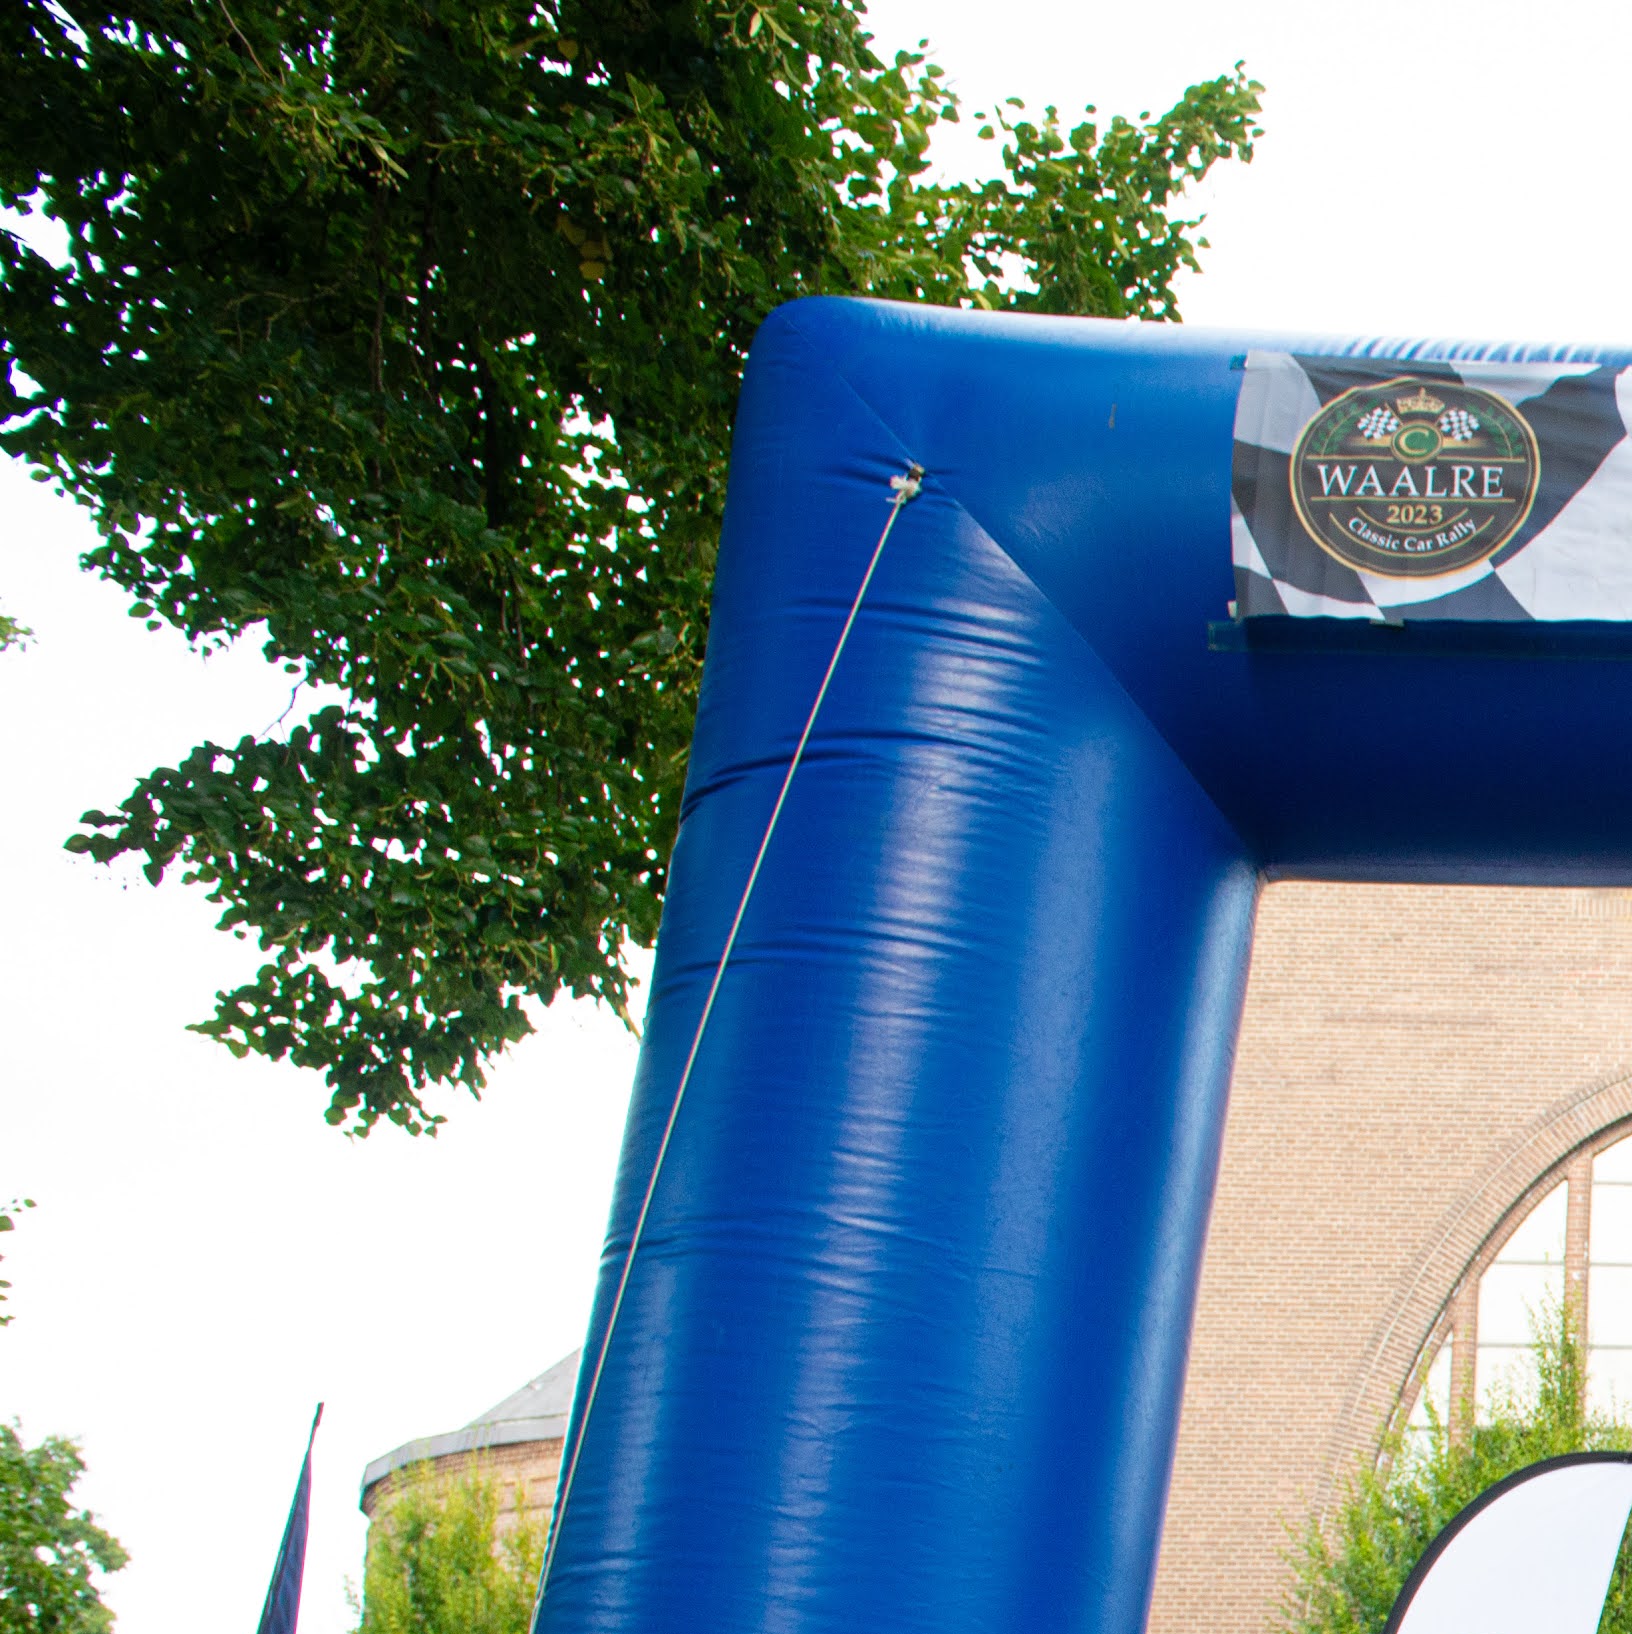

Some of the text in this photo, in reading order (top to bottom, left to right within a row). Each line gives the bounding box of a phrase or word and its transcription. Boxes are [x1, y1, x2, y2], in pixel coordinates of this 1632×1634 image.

[1400, 428, 1430, 454] C
[1317, 464, 1504, 498] WAALRE
[1386, 504, 1443, 524] 2023
[1349, 517, 1477, 551] Classic Car Rally
